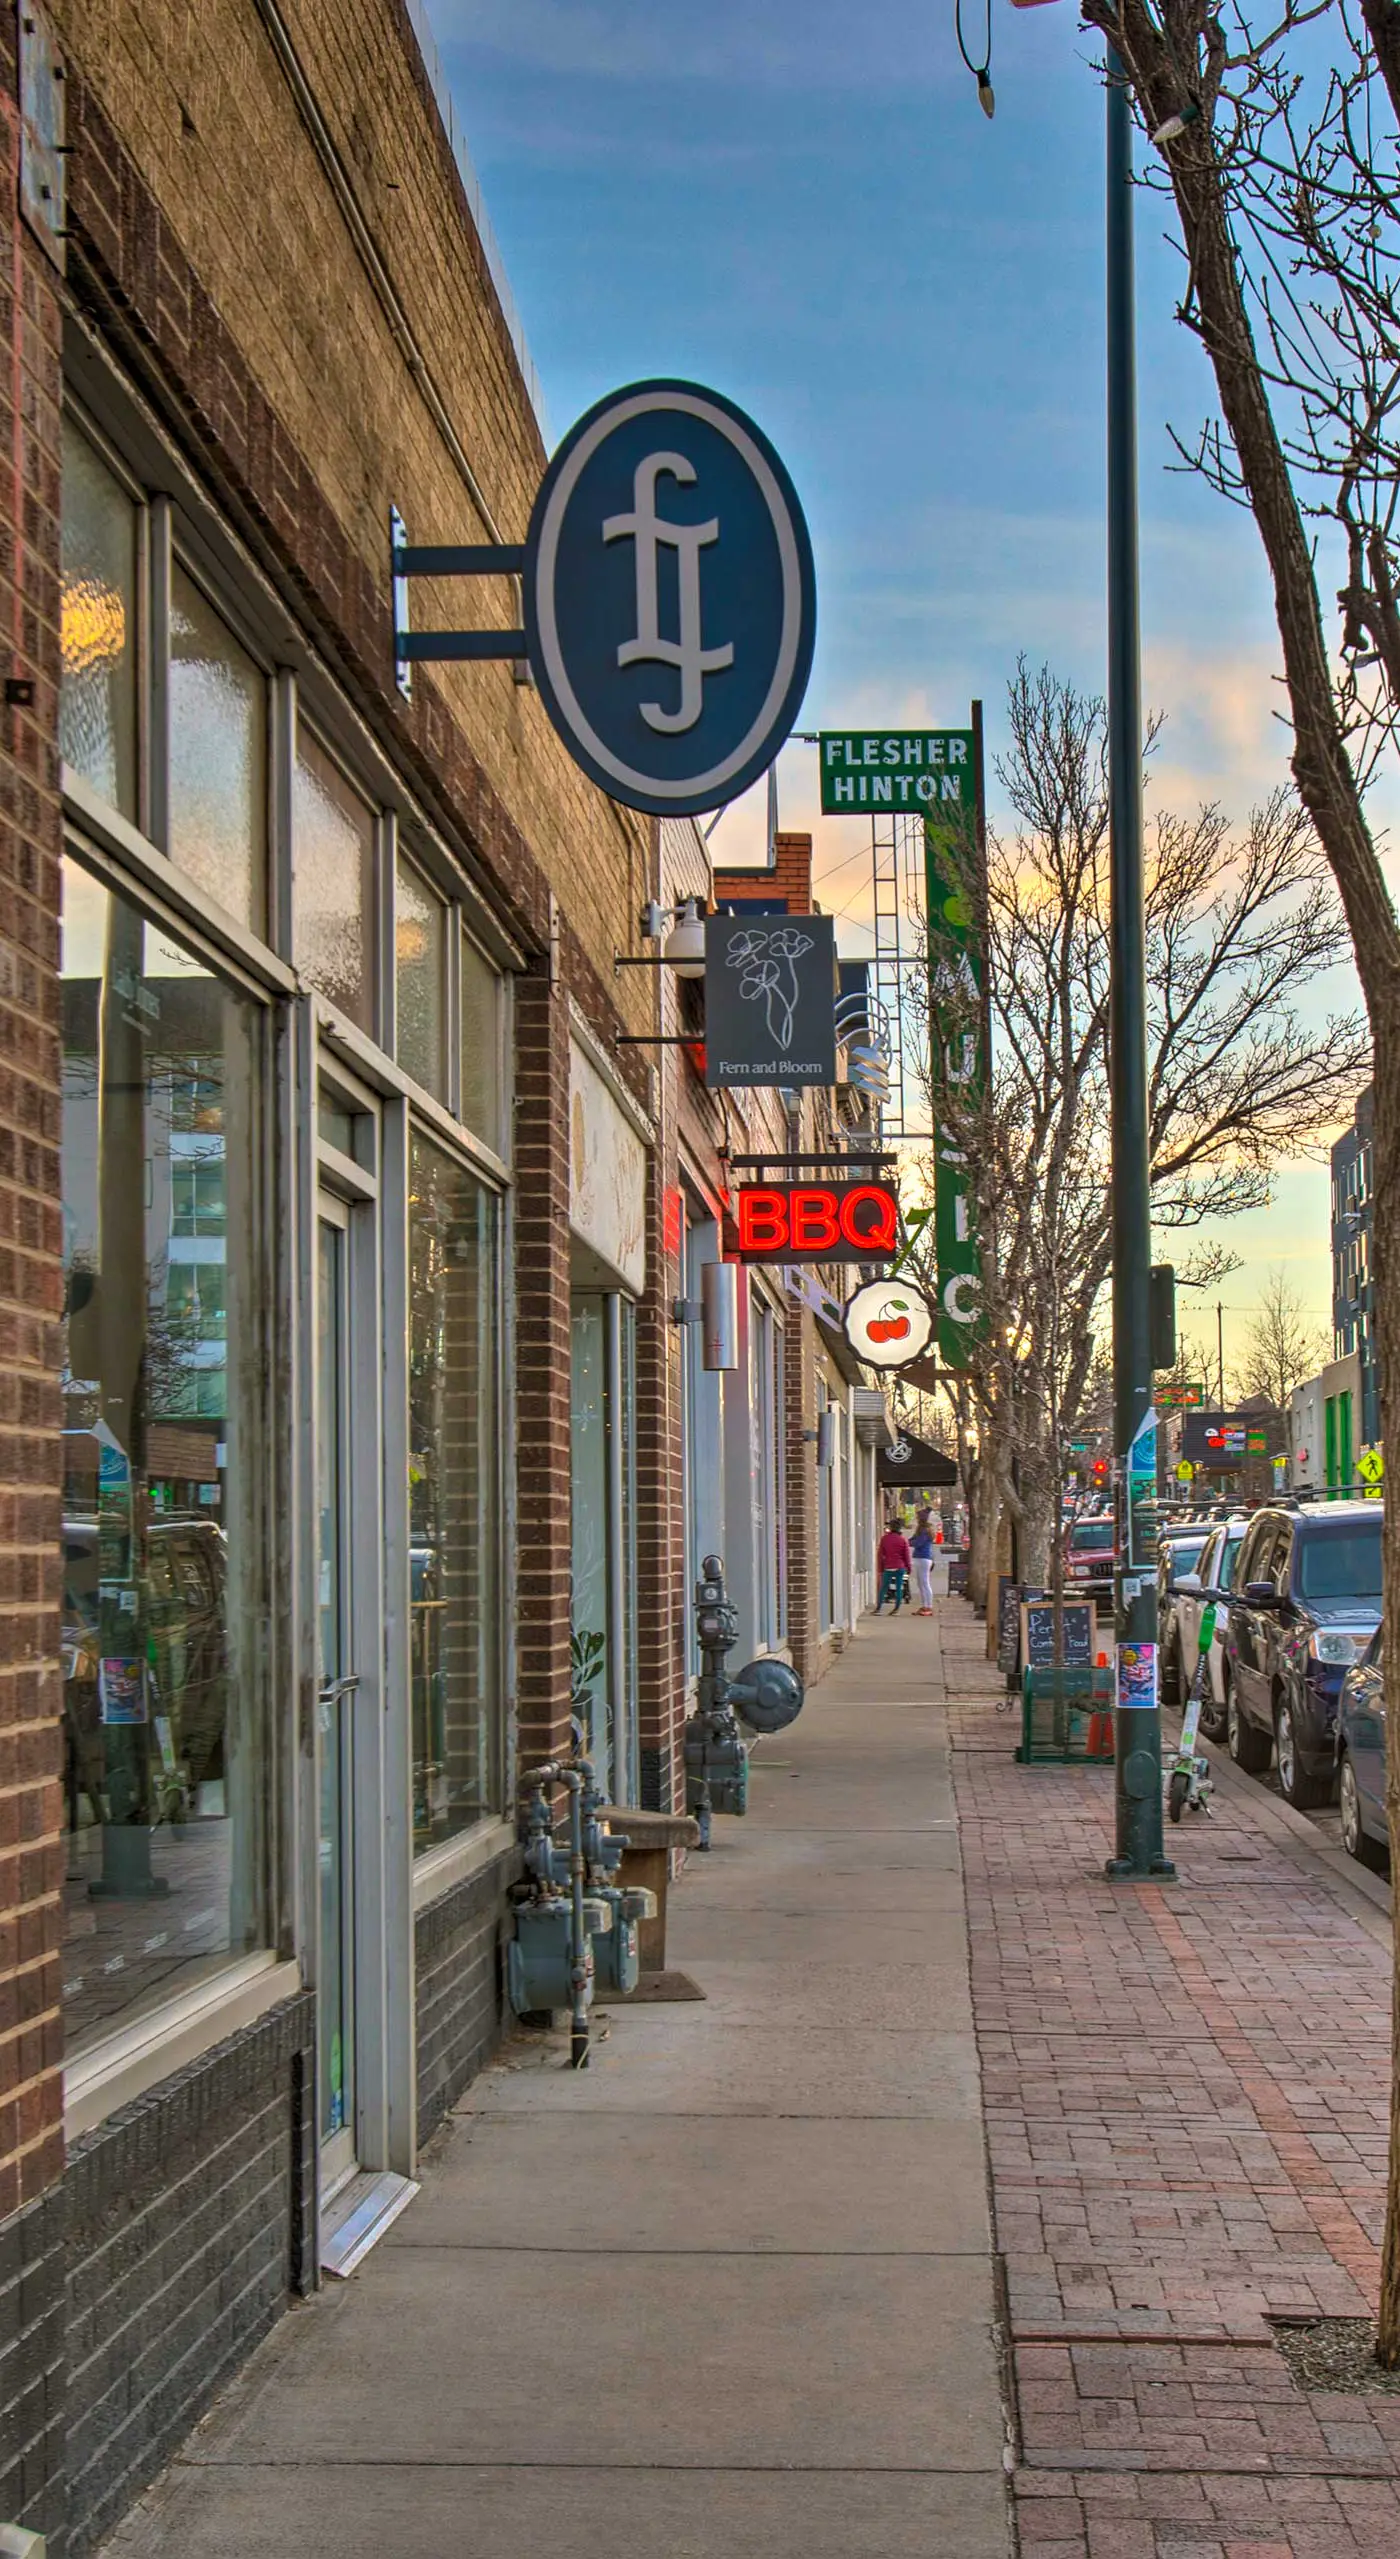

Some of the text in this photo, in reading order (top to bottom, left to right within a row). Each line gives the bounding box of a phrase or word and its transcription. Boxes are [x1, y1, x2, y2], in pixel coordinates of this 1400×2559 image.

[826, 737, 969, 767] FLESHER
[833, 774, 962, 803] HINTON
[719, 1060, 822, 1074] Fern and Bloom
[738, 1185, 897, 1252] BBQ
